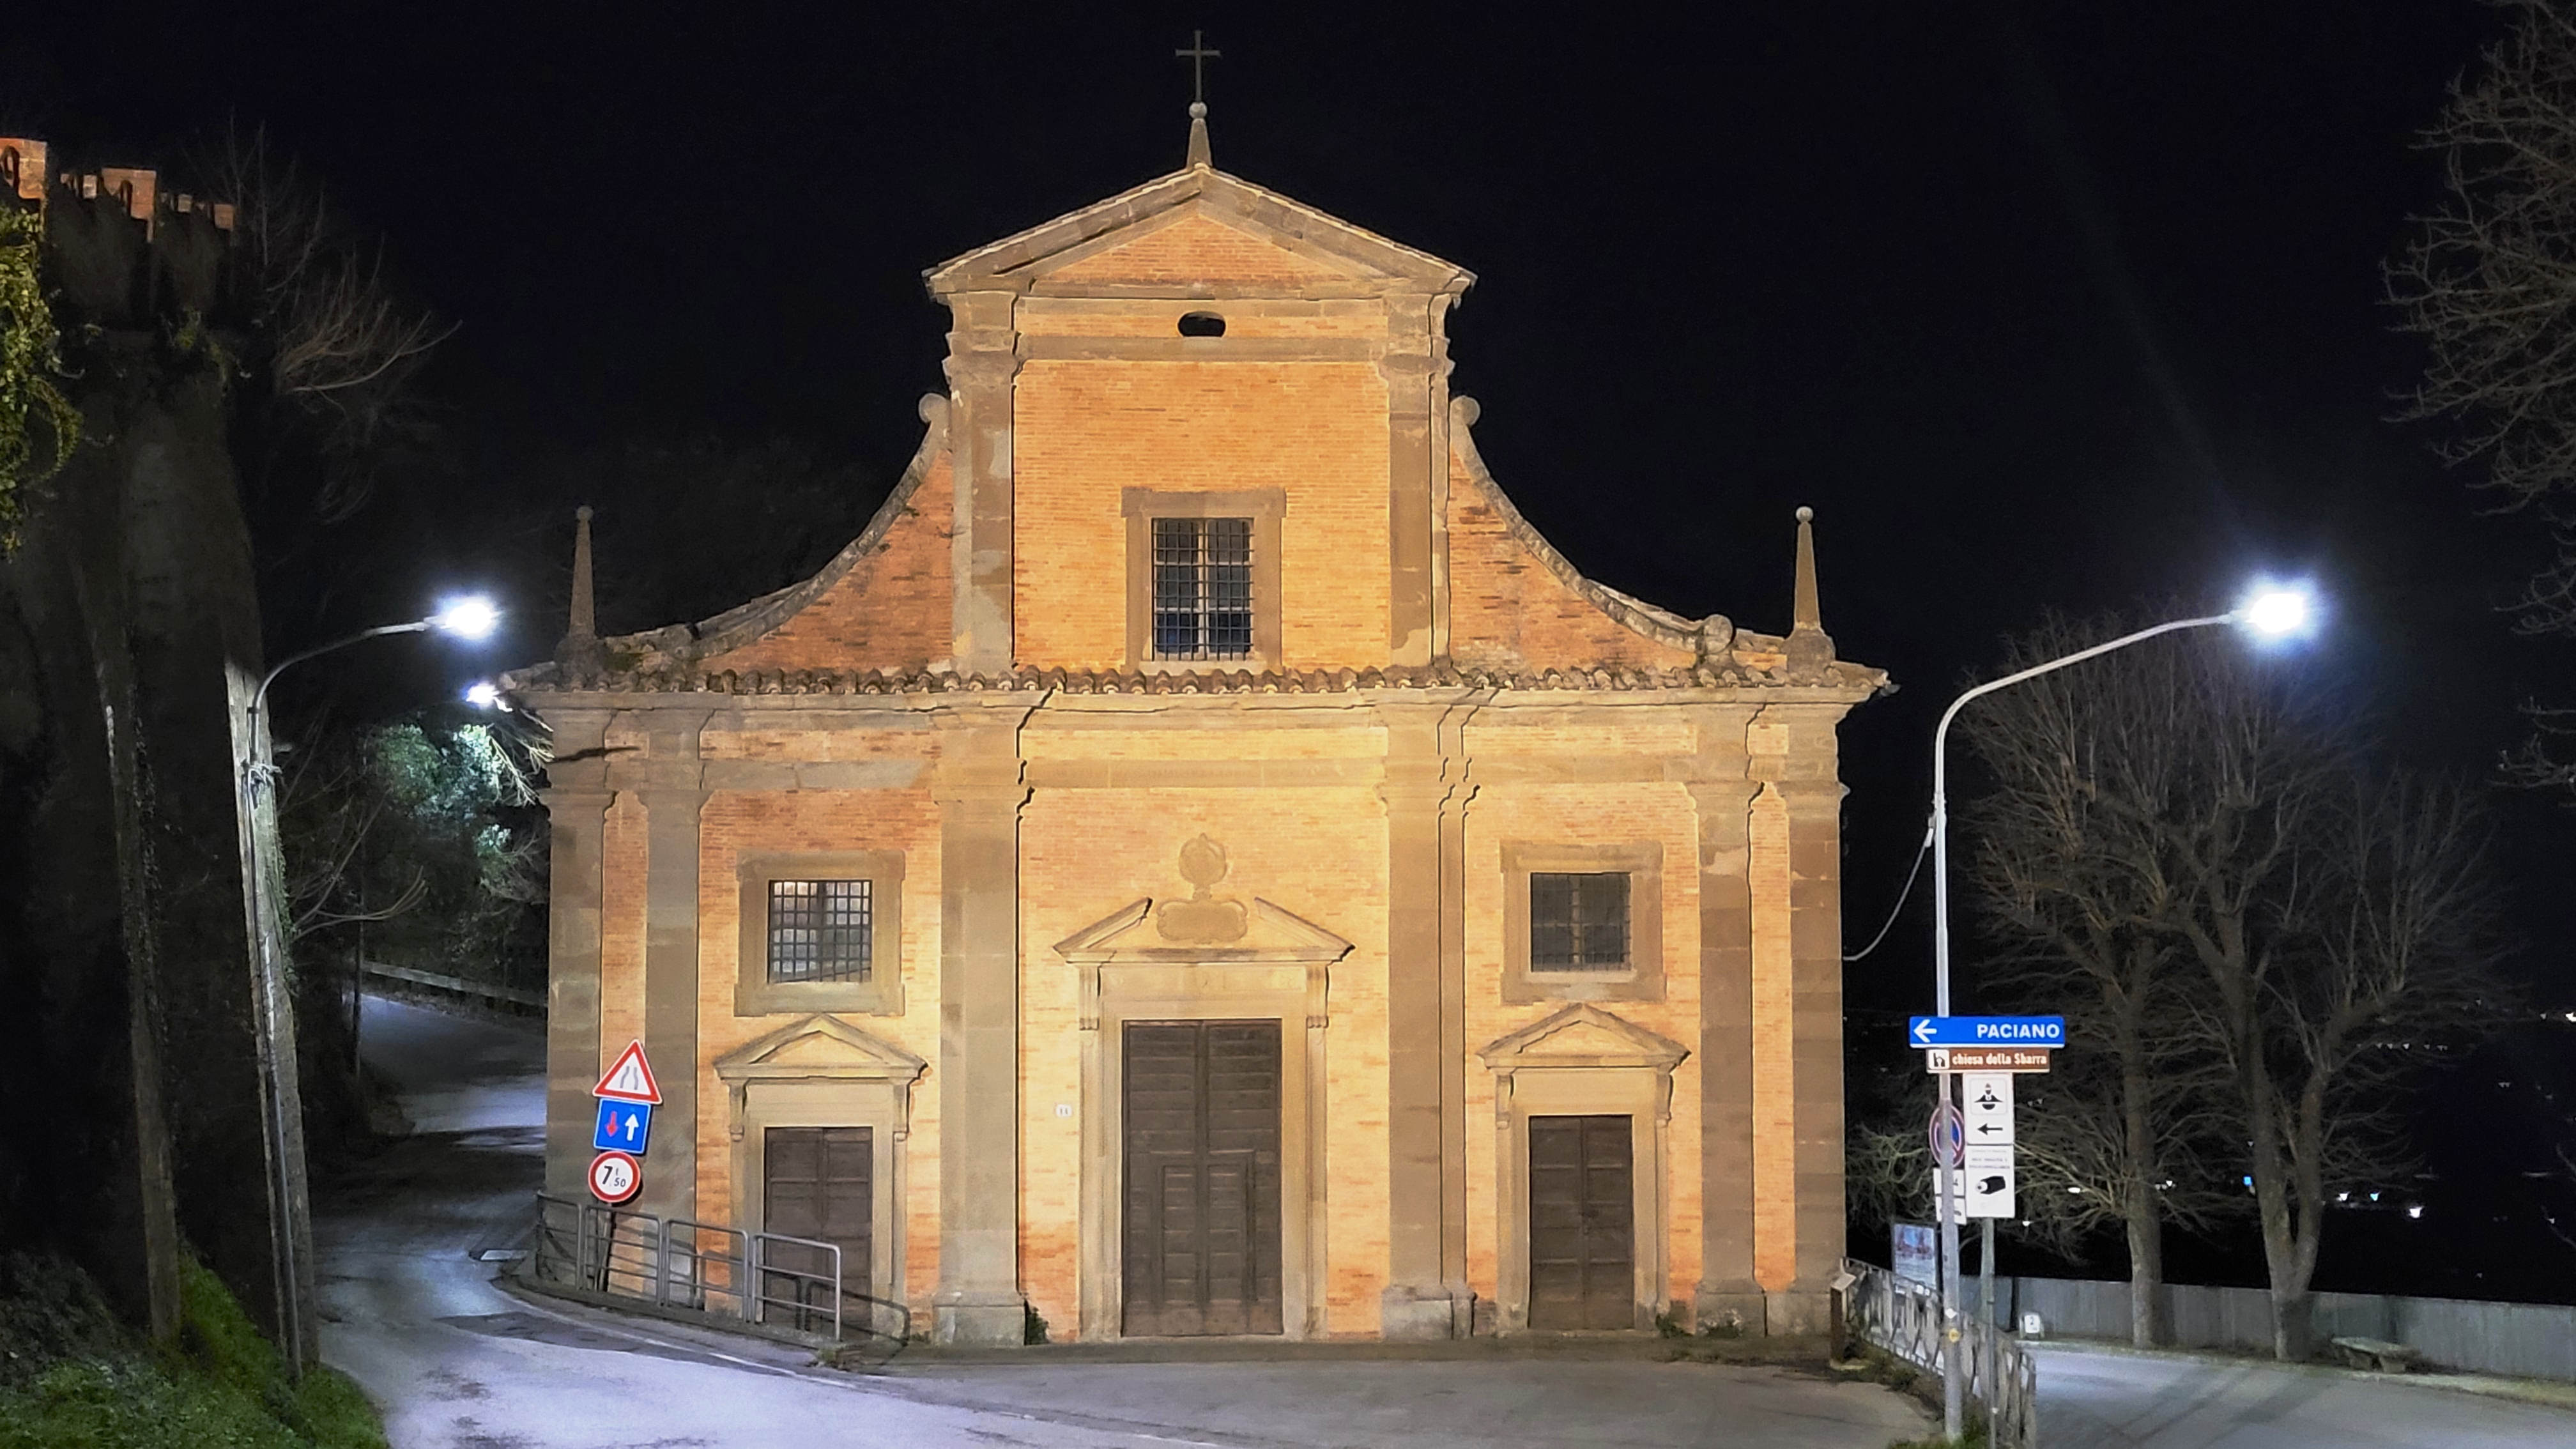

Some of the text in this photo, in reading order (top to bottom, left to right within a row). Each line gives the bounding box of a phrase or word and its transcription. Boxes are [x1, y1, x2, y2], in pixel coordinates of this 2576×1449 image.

[1977, 1023, 2060, 1038] PACIANO
[1952, 1053, 2047, 1065] chiesa della Sbarra
[602, 1165, 613, 1184] 7
[613, 1177, 626, 1188] 50
